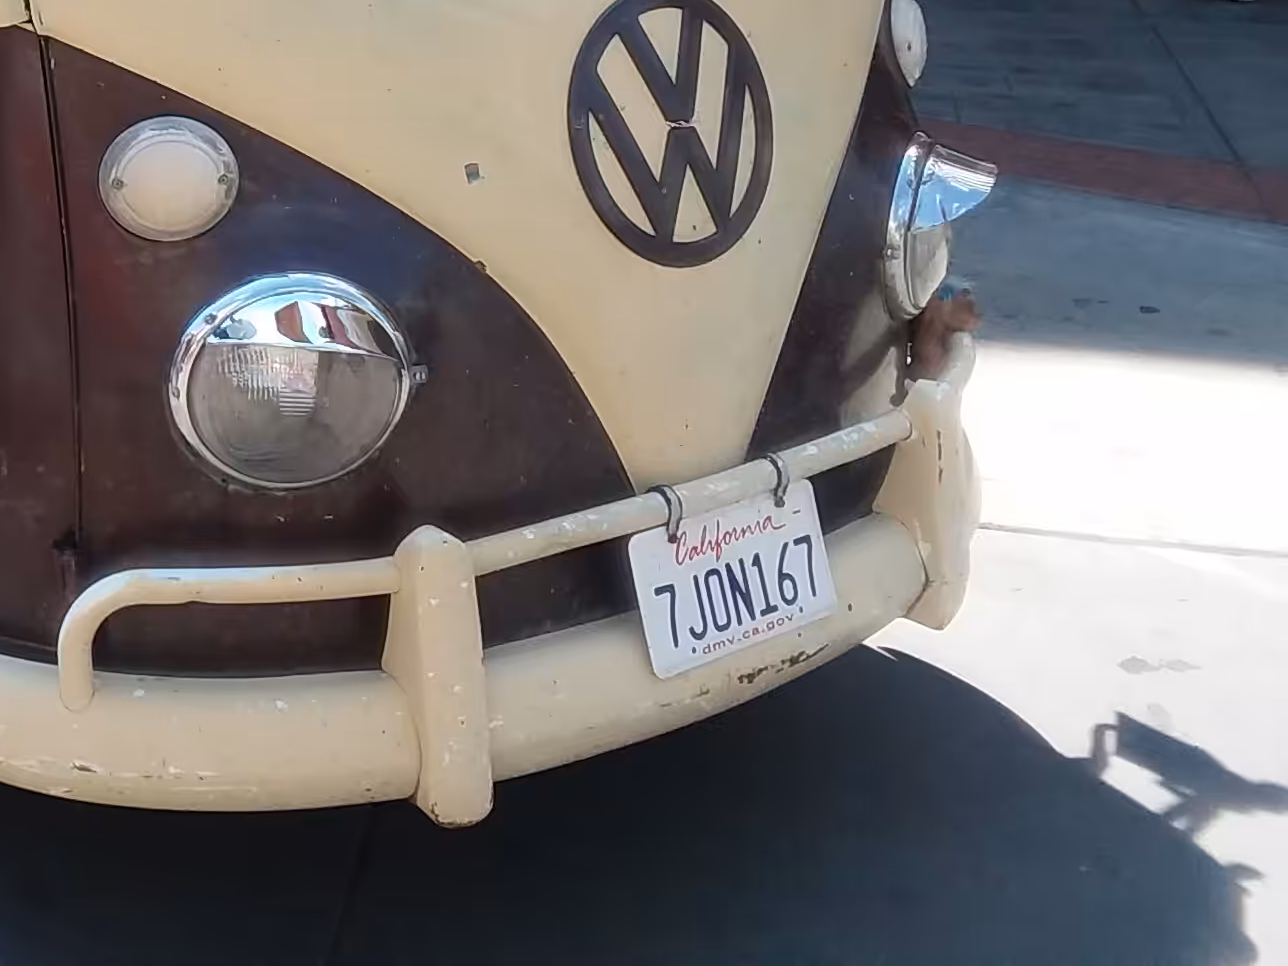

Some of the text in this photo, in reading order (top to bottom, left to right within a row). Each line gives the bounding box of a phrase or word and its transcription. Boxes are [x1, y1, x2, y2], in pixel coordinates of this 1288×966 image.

[675, 514, 787, 566] California
[654, 534, 817, 649] 7JON167
[702, 612, 795, 655] dmv.ca.gov
